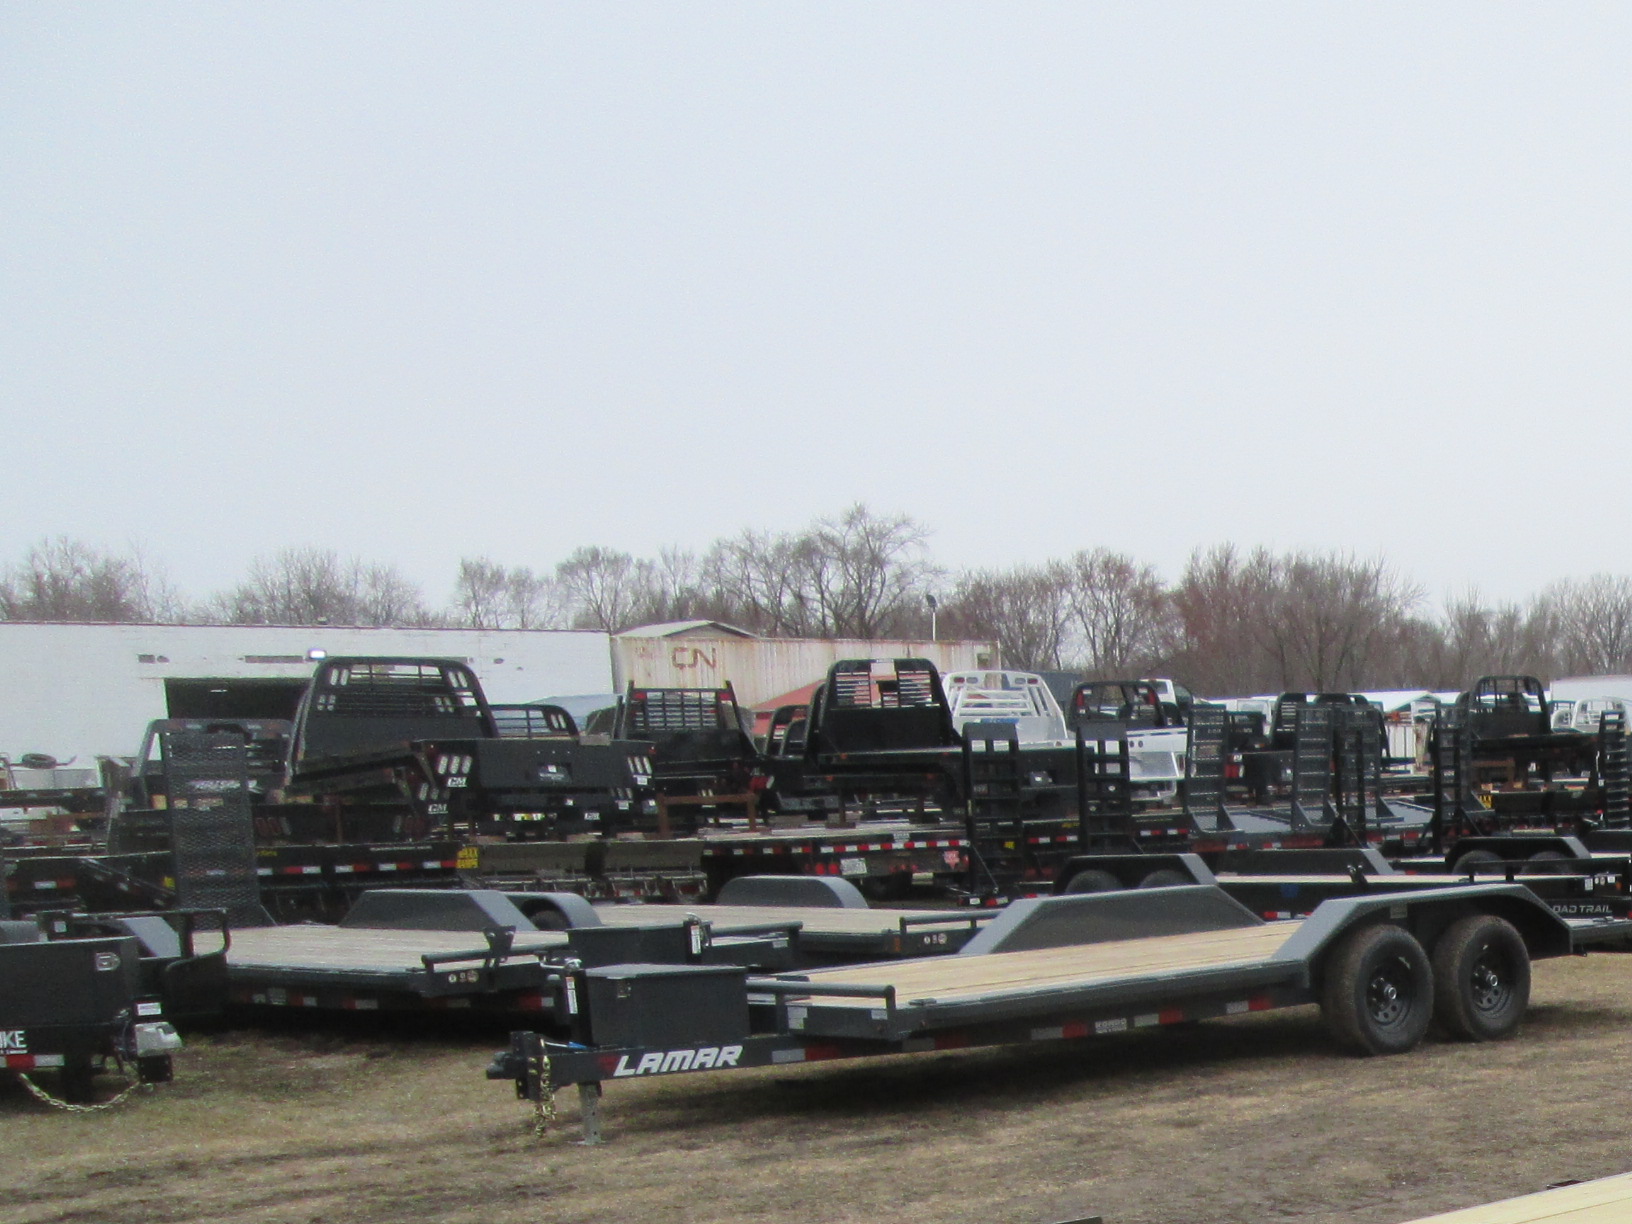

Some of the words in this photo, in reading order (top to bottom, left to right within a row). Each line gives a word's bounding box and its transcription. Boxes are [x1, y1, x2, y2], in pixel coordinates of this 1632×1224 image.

[672, 647, 717, 670] CN
[1551, 905, 1577, 914] OAD
[1578, 905, 1613, 914] TRAIL
[613, 1045, 744, 1078] LAMAR
